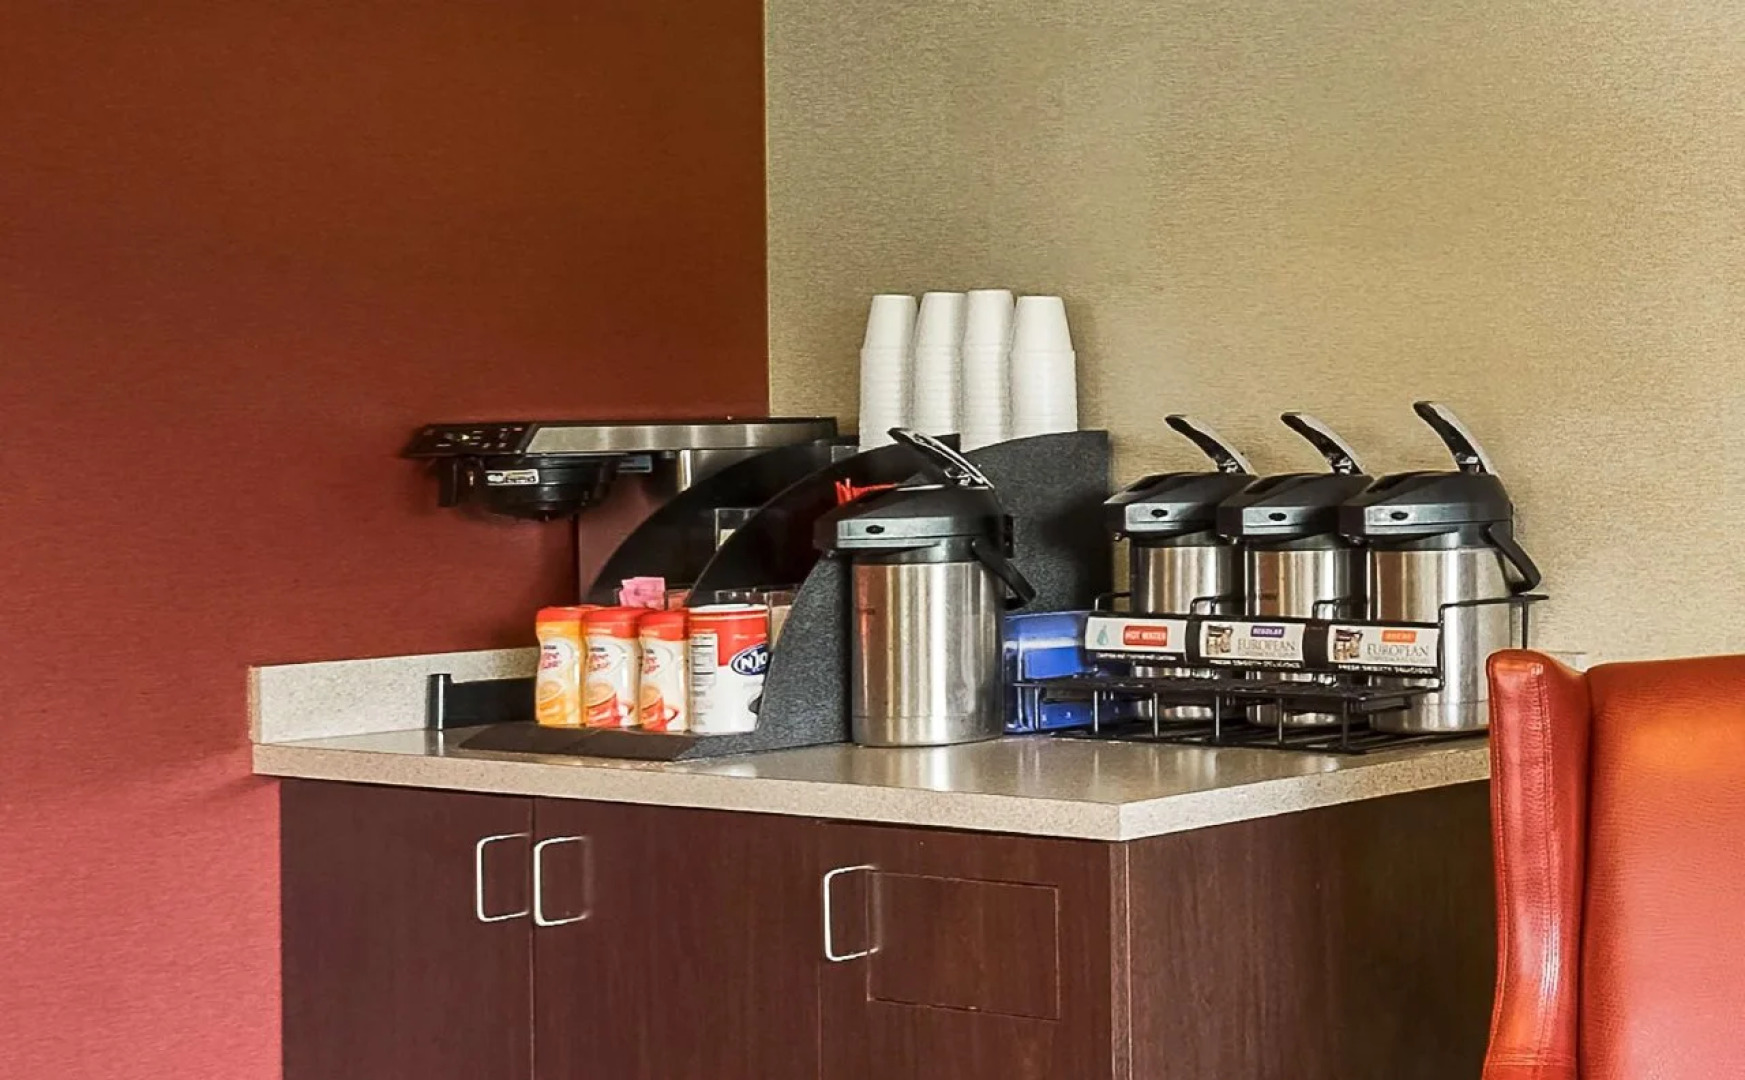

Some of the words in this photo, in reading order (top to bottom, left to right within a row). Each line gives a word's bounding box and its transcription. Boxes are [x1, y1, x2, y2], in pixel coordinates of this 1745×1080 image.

[1125, 630, 1140, 640] HOT
[1141, 631, 1167, 641] WATER
[1252, 627, 1283, 636] REGULAR
[1238, 638, 1296, 651] EUROPEAN
[1367, 643, 1430, 657] EUROPEAN
